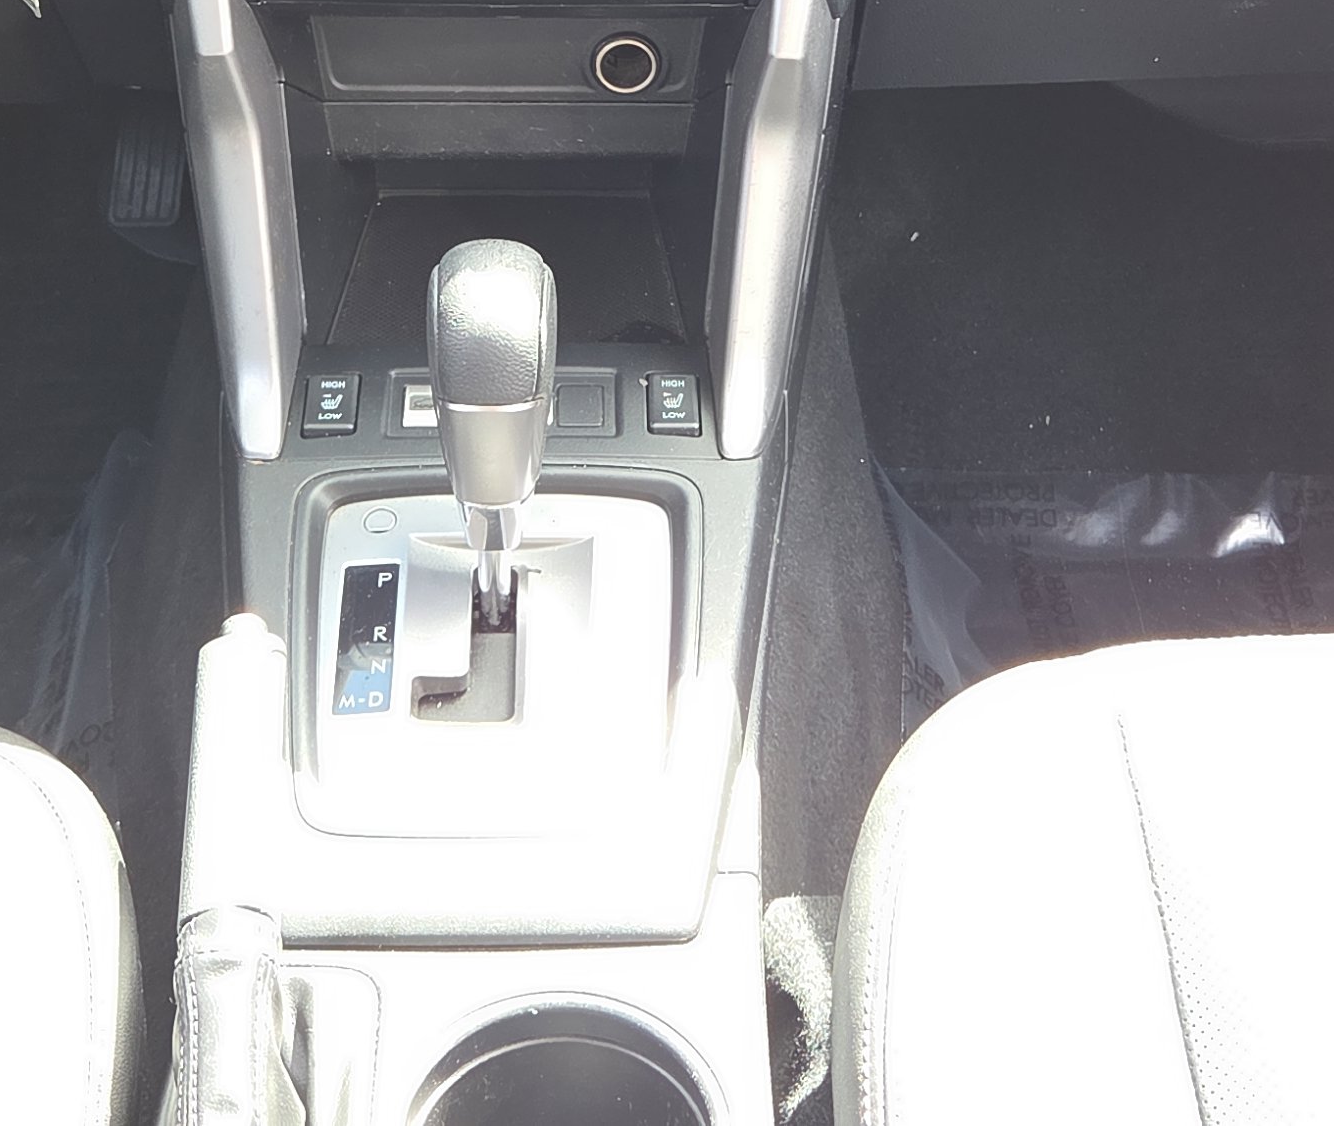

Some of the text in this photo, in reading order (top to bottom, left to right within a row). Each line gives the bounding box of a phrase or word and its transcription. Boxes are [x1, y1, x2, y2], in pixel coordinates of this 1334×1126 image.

[321, 380, 346, 389] HIGH
[661, 379, 685, 388] HIGH
[318, 412, 343, 420] LOW
[662, 411, 686, 419] LOW
[377, 572, 393, 588] P
[373, 626, 387, 642] R
[370, 658, 387, 675] N
